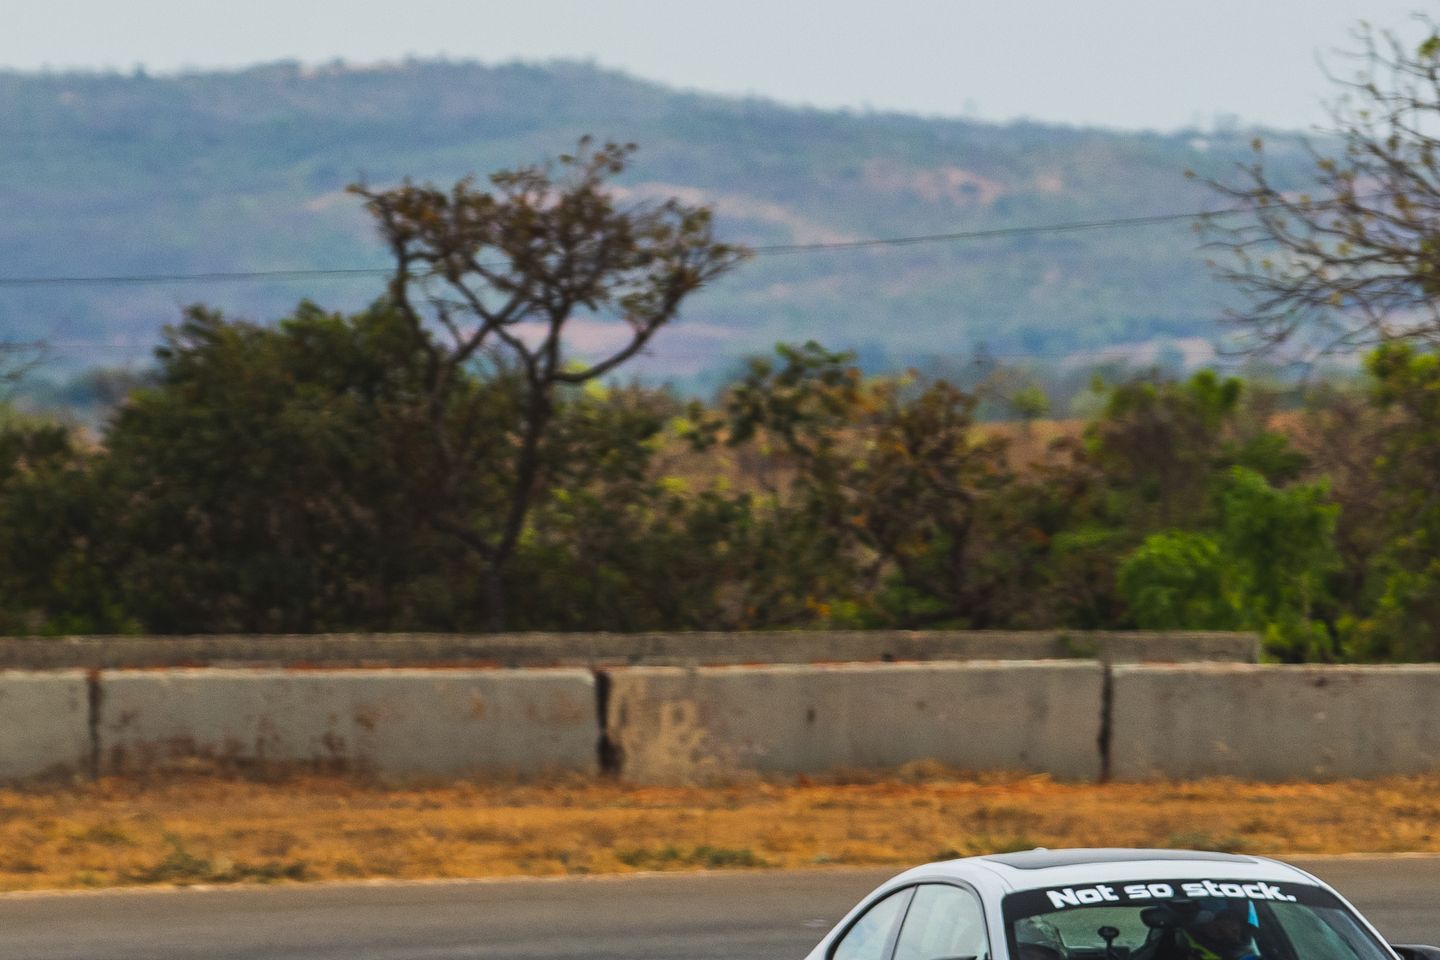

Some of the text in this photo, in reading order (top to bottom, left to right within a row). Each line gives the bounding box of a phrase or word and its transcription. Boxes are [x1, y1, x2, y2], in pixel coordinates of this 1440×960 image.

[1046, 879, 1297, 909] Not so stock.
